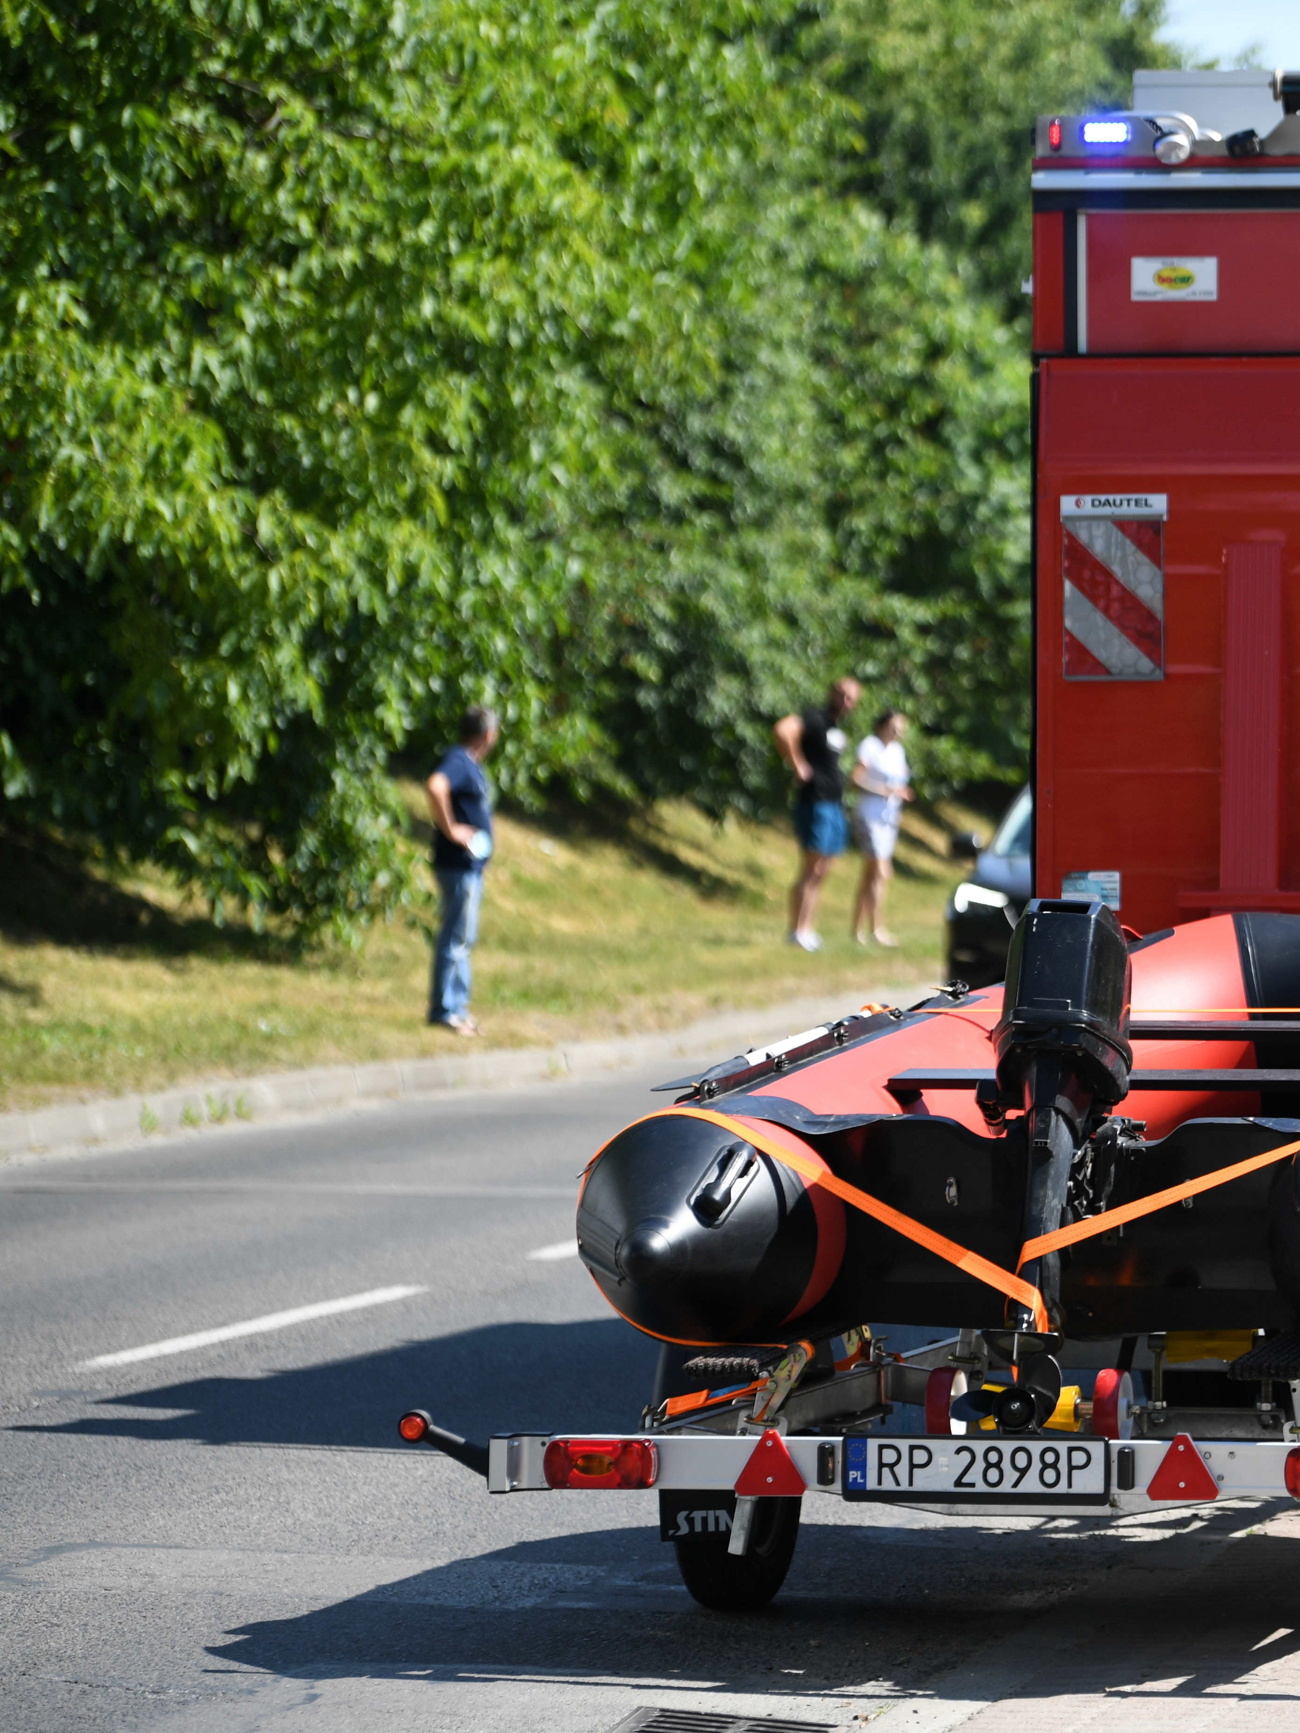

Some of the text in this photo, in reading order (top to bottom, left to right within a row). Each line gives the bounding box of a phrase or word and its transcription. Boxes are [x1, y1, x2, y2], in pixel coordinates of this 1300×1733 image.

[1090, 497, 1153, 508] DAUTEL
[876, 1443, 1092, 1489] RP 2898P
[848, 1470, 865, 1483] PL
